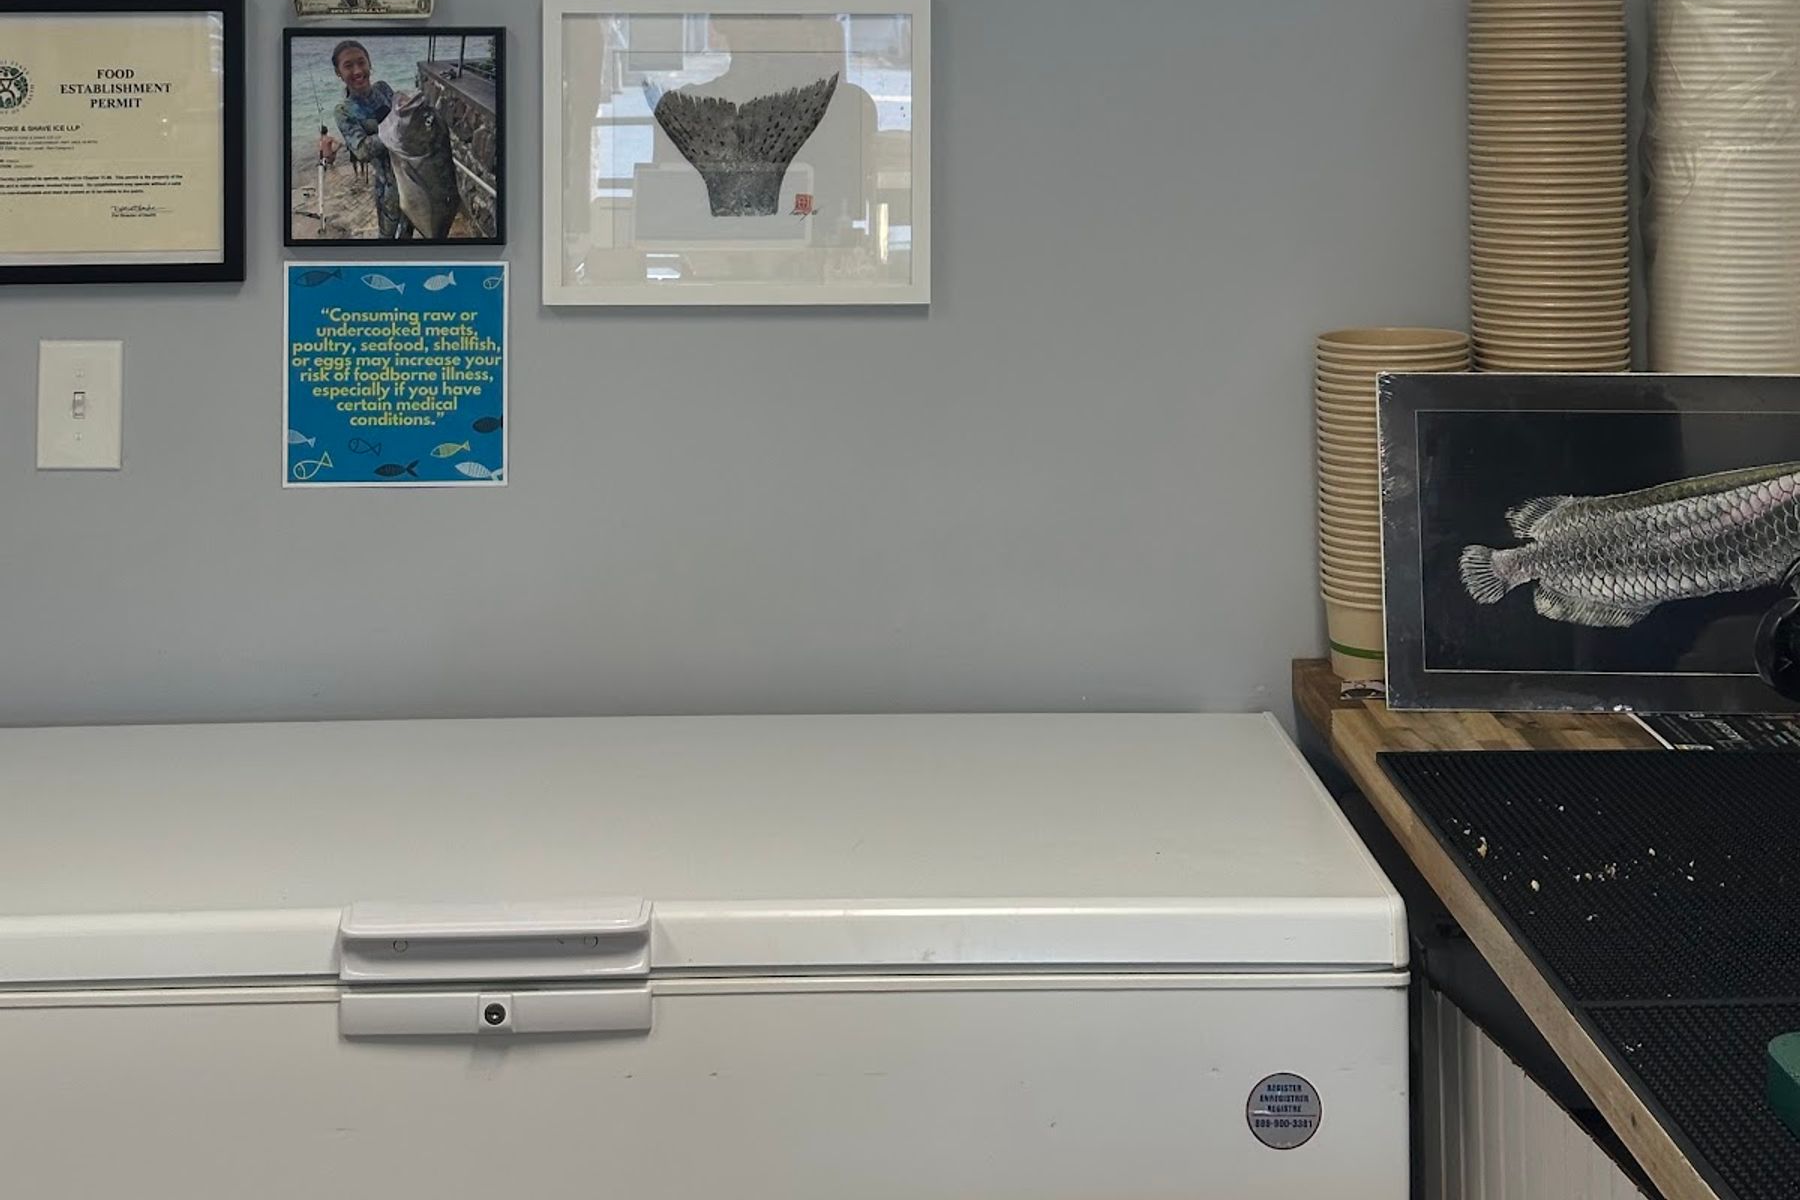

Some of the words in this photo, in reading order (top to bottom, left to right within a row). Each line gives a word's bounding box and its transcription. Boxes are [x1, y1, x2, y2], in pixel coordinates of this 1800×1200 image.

[97, 69, 135, 79] FOOD
[60, 83, 171, 94] ESTABLISHMENT
[90, 98, 142, 108] PERMIT
[423, 312, 456, 321] raw
[460, 311, 478, 321] or
[316, 324, 421, 336] undercooked
[425, 326, 478, 337] meats,
[293, 338, 356, 356] poultry,
[360, 338, 429, 353] seafood,
[433, 336, 501, 353] shellfish,
[292, 357, 310, 366] or
[314, 356, 352, 371] eggs
[356, 357, 391, 370] may
[395, 353, 461, 366] increase
[465, 356, 502, 369] your
[300, 369, 329, 382] risk
[334, 369, 351, 381] of
[354, 368, 437, 381] foodborne
[441, 368, 494, 383] illness,
[312, 382, 390, 399] especially
[394, 383, 405, 396] if
[409, 386, 438, 400] you
[442, 382, 482, 396] have
[336, 398, 392, 411] certain
[396, 397, 457, 411] medical
